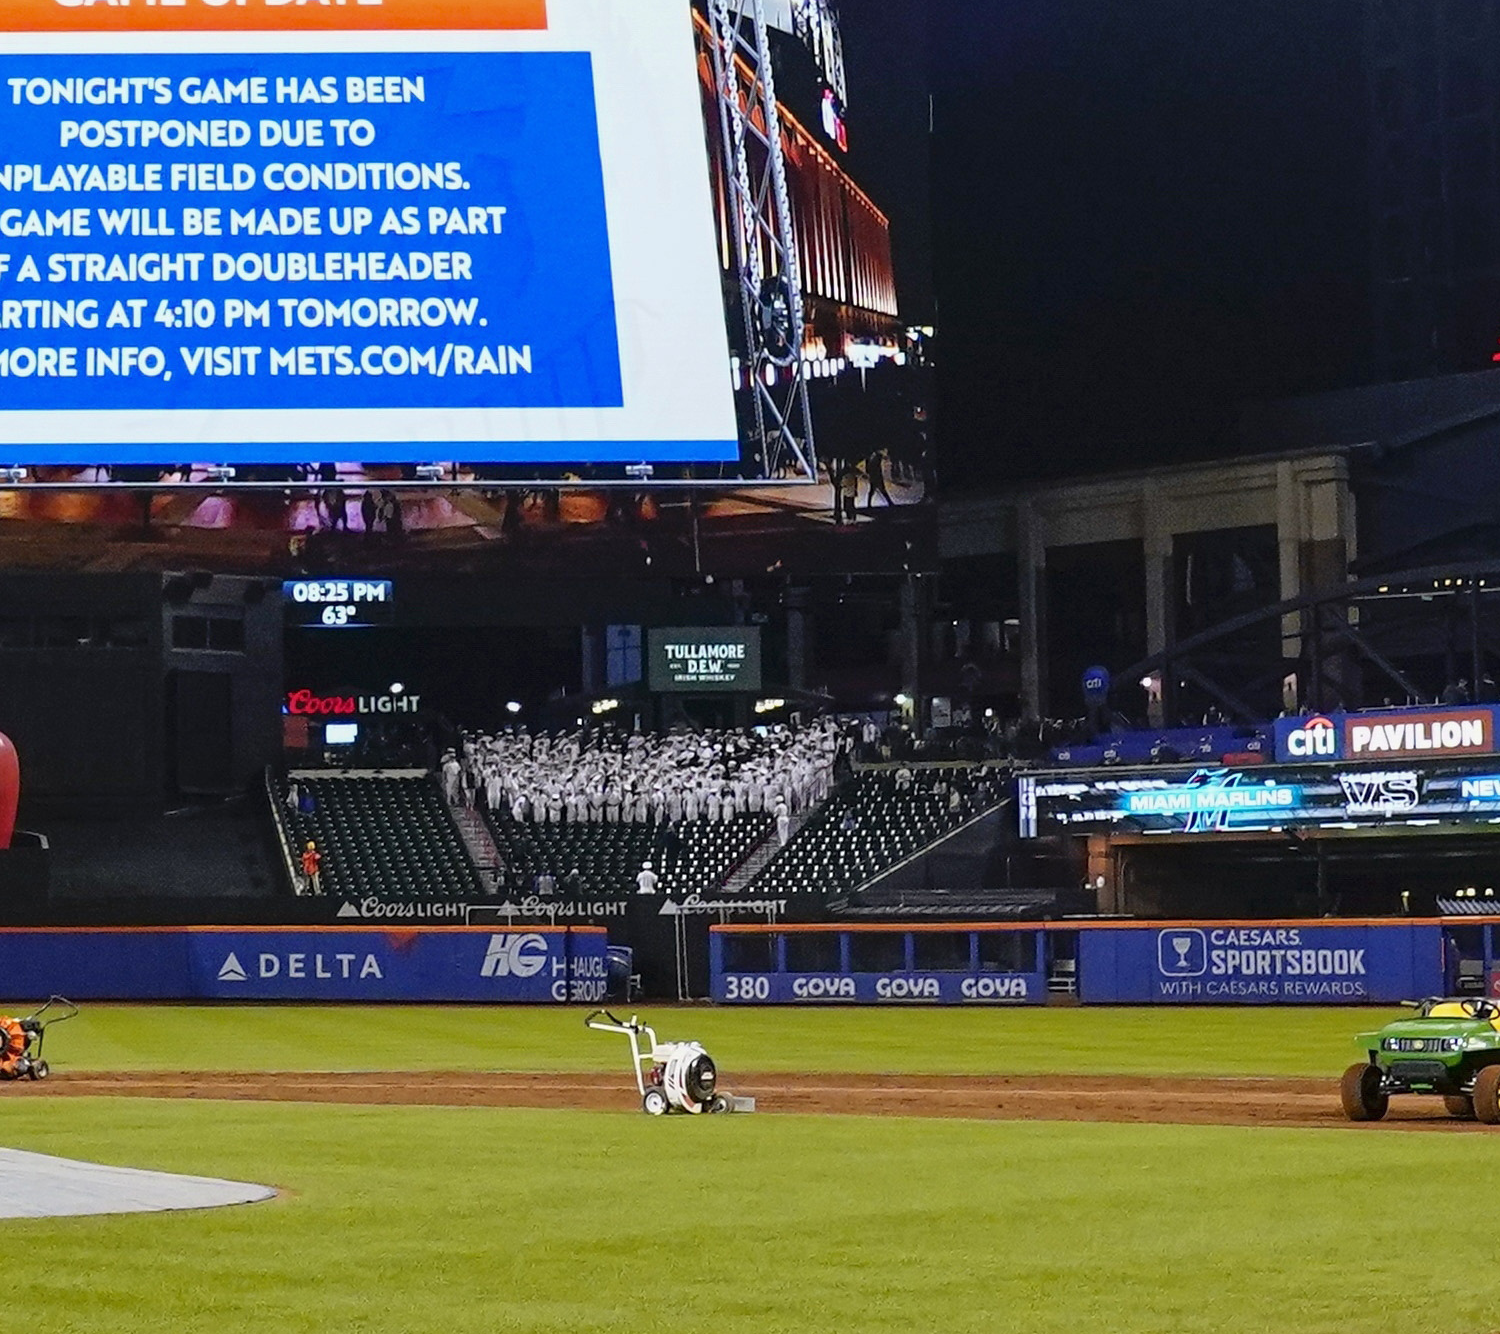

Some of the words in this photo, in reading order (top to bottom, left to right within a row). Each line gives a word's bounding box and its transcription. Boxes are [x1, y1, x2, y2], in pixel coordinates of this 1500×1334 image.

[8, 77, 172, 104] TONIGHT'S
[179, 77, 268, 104] GAME
[277, 77, 338, 103] HAS
[347, 77, 425, 103] BEEN
[60, 120, 250, 147] POSTPONED
[260, 120, 321, 147] DUE
[328, 119, 375, 146] TO
[171, 164, 255, 191] FIELD
[264, 163, 471, 191] CONDITIONS.
[0, 209, 89, 236] GAME
[96, 209, 174, 236] WILL
[184, 208, 221, 236] BE
[231, 208, 321, 235] MADE
[330, 208, 372, 235] UP
[379, 207, 420, 235] AS
[429, 207, 507, 235] PART
[14, 254, 40, 281] A
[49, 253, 204, 282] STRAIGHT
[213, 252, 473, 281] DOUBLEHEADER
[108, 299, 147, 328] AT
[154, 299, 215, 328] 4:10
[224, 299, 270, 328] PM
[278, 298, 488, 327] TOMORROW.
[87, 347, 172, 382] INFO,
[180, 347, 262, 376] VISIT
[270, 344, 532, 376] METS.COM/RAIN
[293, 582, 349, 602] 08:25
[353, 582, 386, 602] PM
[664, 644, 746, 659] TULLAMORE
[288, 689, 356, 714] Coors
[358, 695, 421, 713] LIGHT
[1288, 723, 1336, 756] citi
[1352, 719, 1484, 753] PAVILION
[1129, 792, 1191, 812] MIAMI
[1196, 788, 1293, 809] MARLINS
[360, 896, 415, 919] Coors
[417, 902, 468, 918] LIGHT
[519, 896, 575, 918] Coors
[577, 900, 628, 917] LIGHT
[259, 953, 384, 979] DELTA
[1210, 949, 1366, 975] SPORTSBOOK
[725, 976, 770, 1000] 380
[792, 977, 856, 997] GOYA
[876, 977, 940, 997] GOYA
[961, 977, 1027, 997] GOYA
[1160, 981, 1201, 995] WITH
[1206, 981, 1279, 996] CAESARS
